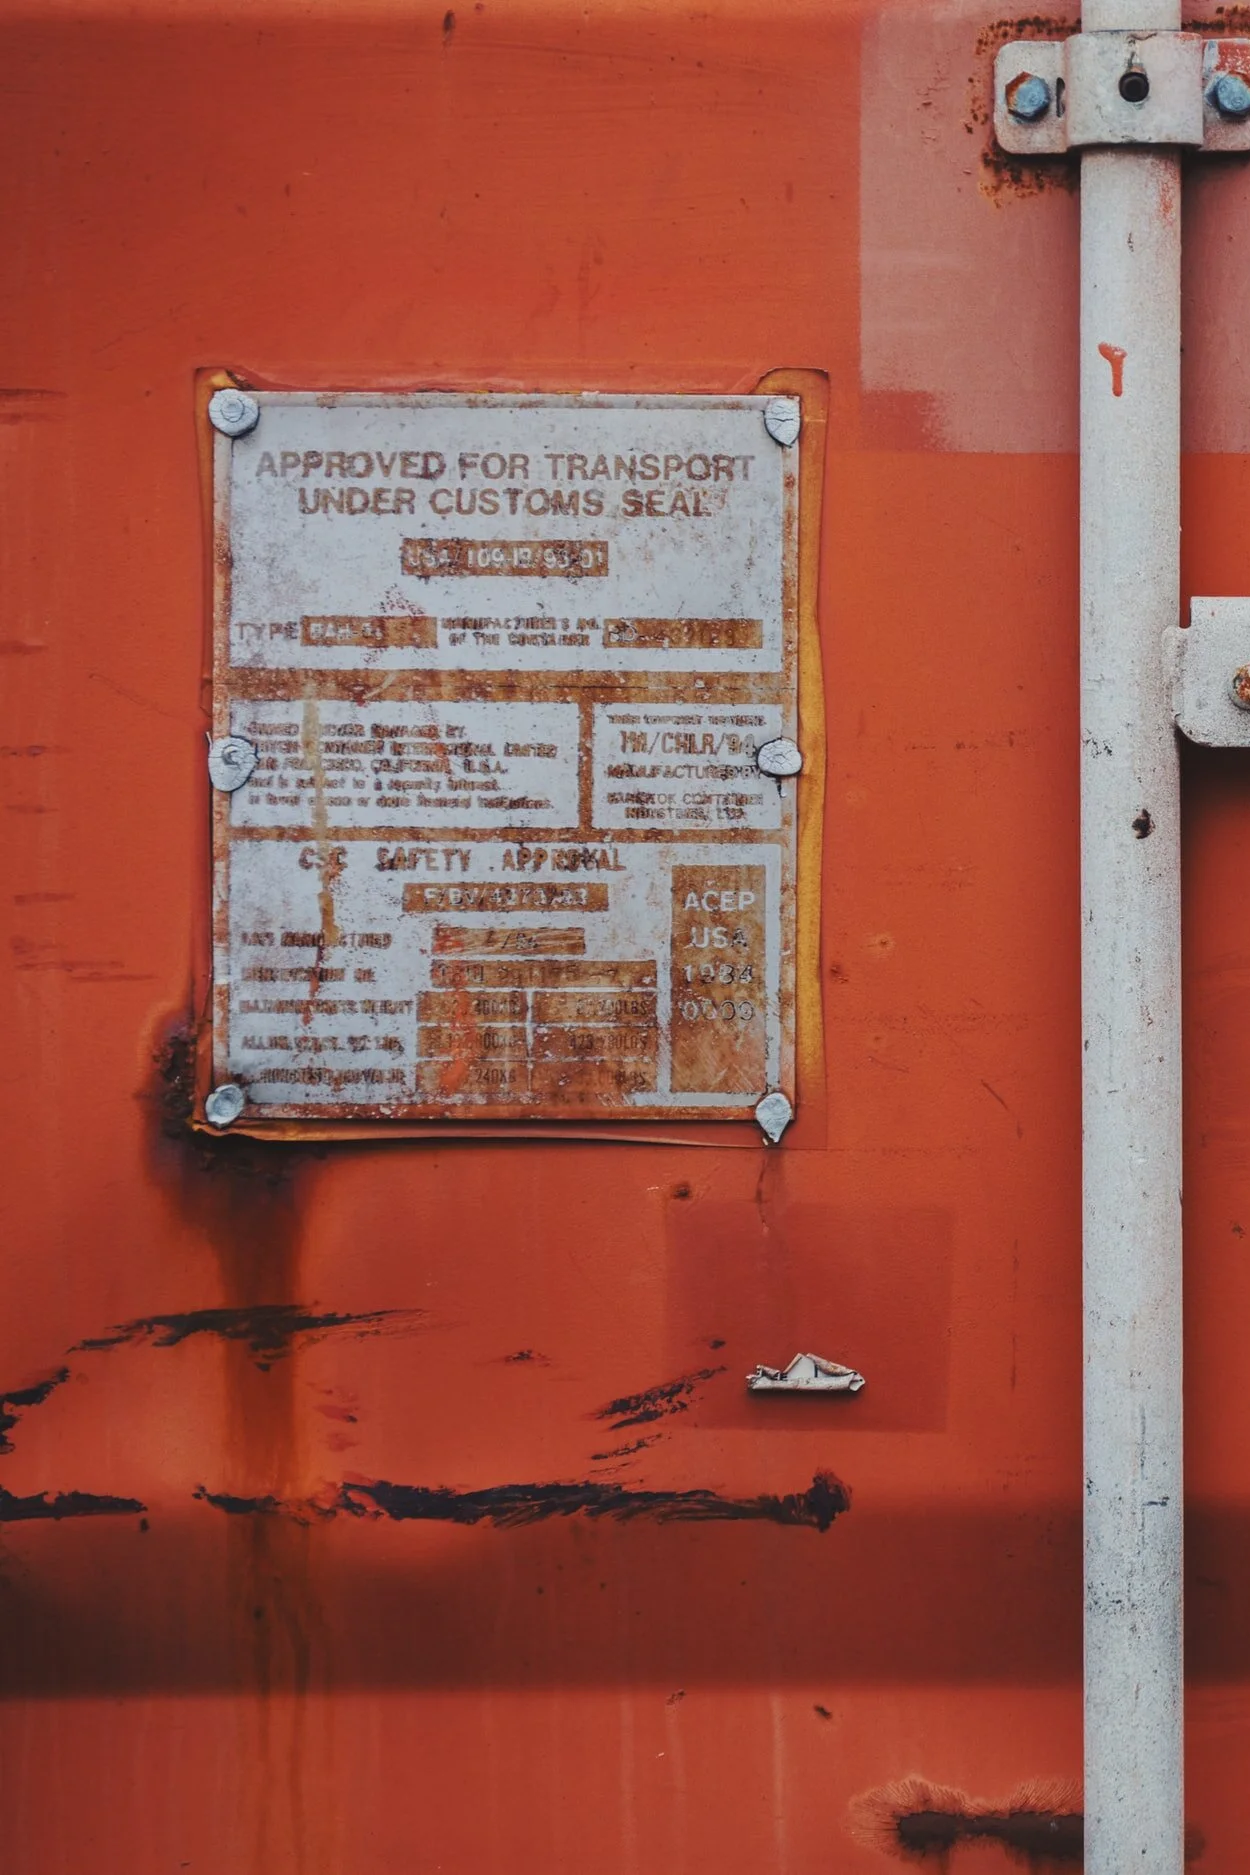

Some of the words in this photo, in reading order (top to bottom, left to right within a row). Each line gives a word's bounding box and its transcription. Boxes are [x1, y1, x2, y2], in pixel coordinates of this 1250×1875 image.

[255, 450, 446, 480] APPROVED
[458, 452, 530, 480] FOR
[544, 453, 755, 482] TRANSPORT
[299, 487, 416, 516] UNDER
[428, 487, 605, 517] CUSTOMS
[621, 489, 713, 518] SEAL
[235, 620, 299, 641] TYPE
[377, 847, 472, 871] SAFETY
[502, 847, 626, 872] APPROVAL
[683, 890, 755, 912] ACEP
[690, 926, 750, 951] USA
